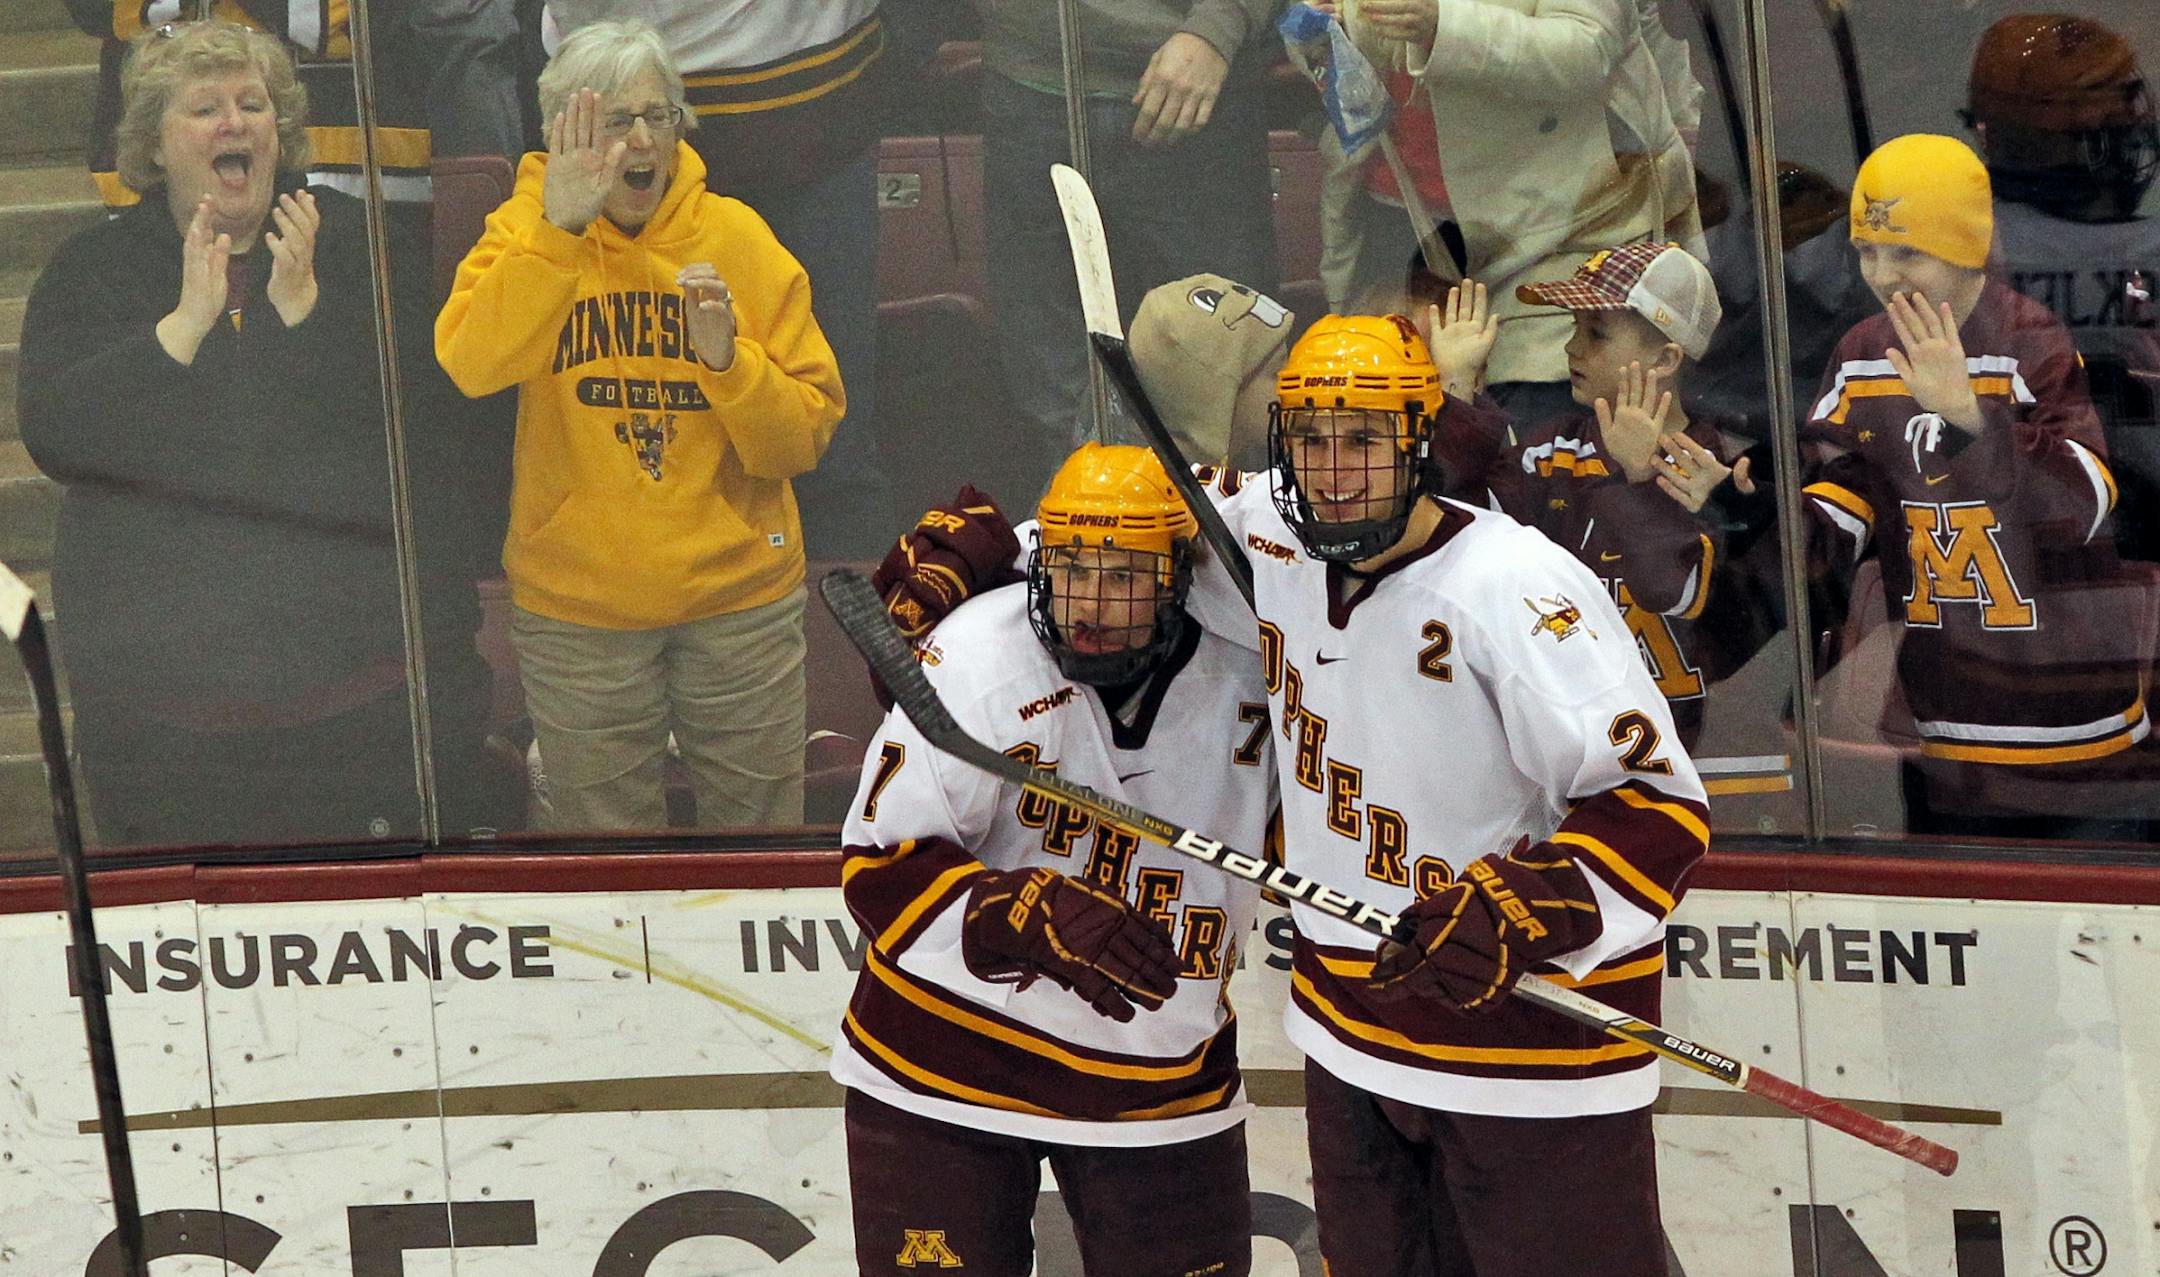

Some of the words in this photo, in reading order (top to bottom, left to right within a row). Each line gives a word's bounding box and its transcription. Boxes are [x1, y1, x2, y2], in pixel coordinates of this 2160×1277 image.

[886, 180, 901, 200] 2
[591, 384, 703, 404] FOTBALL
[1304, 376, 1348, 387] GOPHERS
[1069, 514, 1119, 527] GOPHERS
[1902, 499, 2037, 631] M
[1417, 619, 1453, 683] 2
[1233, 702, 1271, 765] 7
[1257, 618, 1457, 903] OPHERS
[1608, 709, 1673, 776] 2
[862, 740, 906, 823] 7
[1143, 816, 1175, 837] NXG
[1007, 867, 1058, 934] BAU
[1465, 857, 1548, 941] AUER
[65, 925, 554, 997] INSURANCE
[1665, 923, 1979, 987] REMENT
[1663, 1036, 1736, 1072] BAUER
[896, 1229, 964, 1268] M
